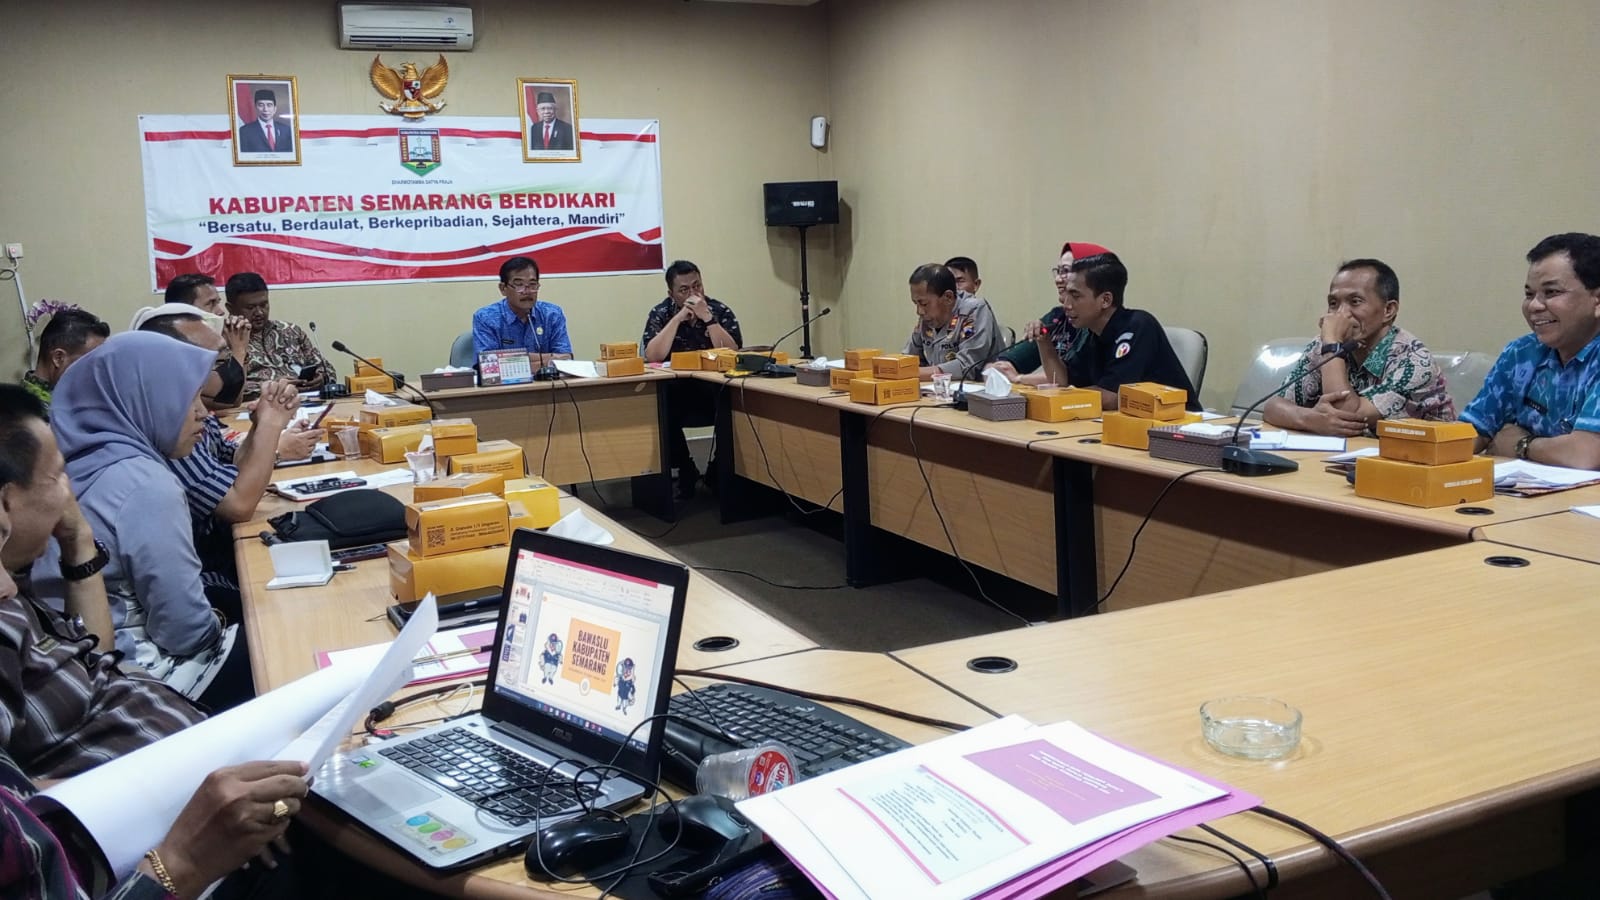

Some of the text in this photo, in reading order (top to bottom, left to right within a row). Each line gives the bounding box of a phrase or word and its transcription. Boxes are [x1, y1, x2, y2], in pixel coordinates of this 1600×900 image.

[209, 192, 615, 214] KABUPATEN SEMARANG BERDIKARI
[282, 217, 363, 231] Berdaulat,
[368, 215, 488, 230] Berkepribadian,
[492, 214, 564, 228] Sejahtera,
[578, 630, 608, 649] BAWASLU
[572, 640, 610, 663] KABUPATEN
[572, 653, 606, 675] SEMARANG
